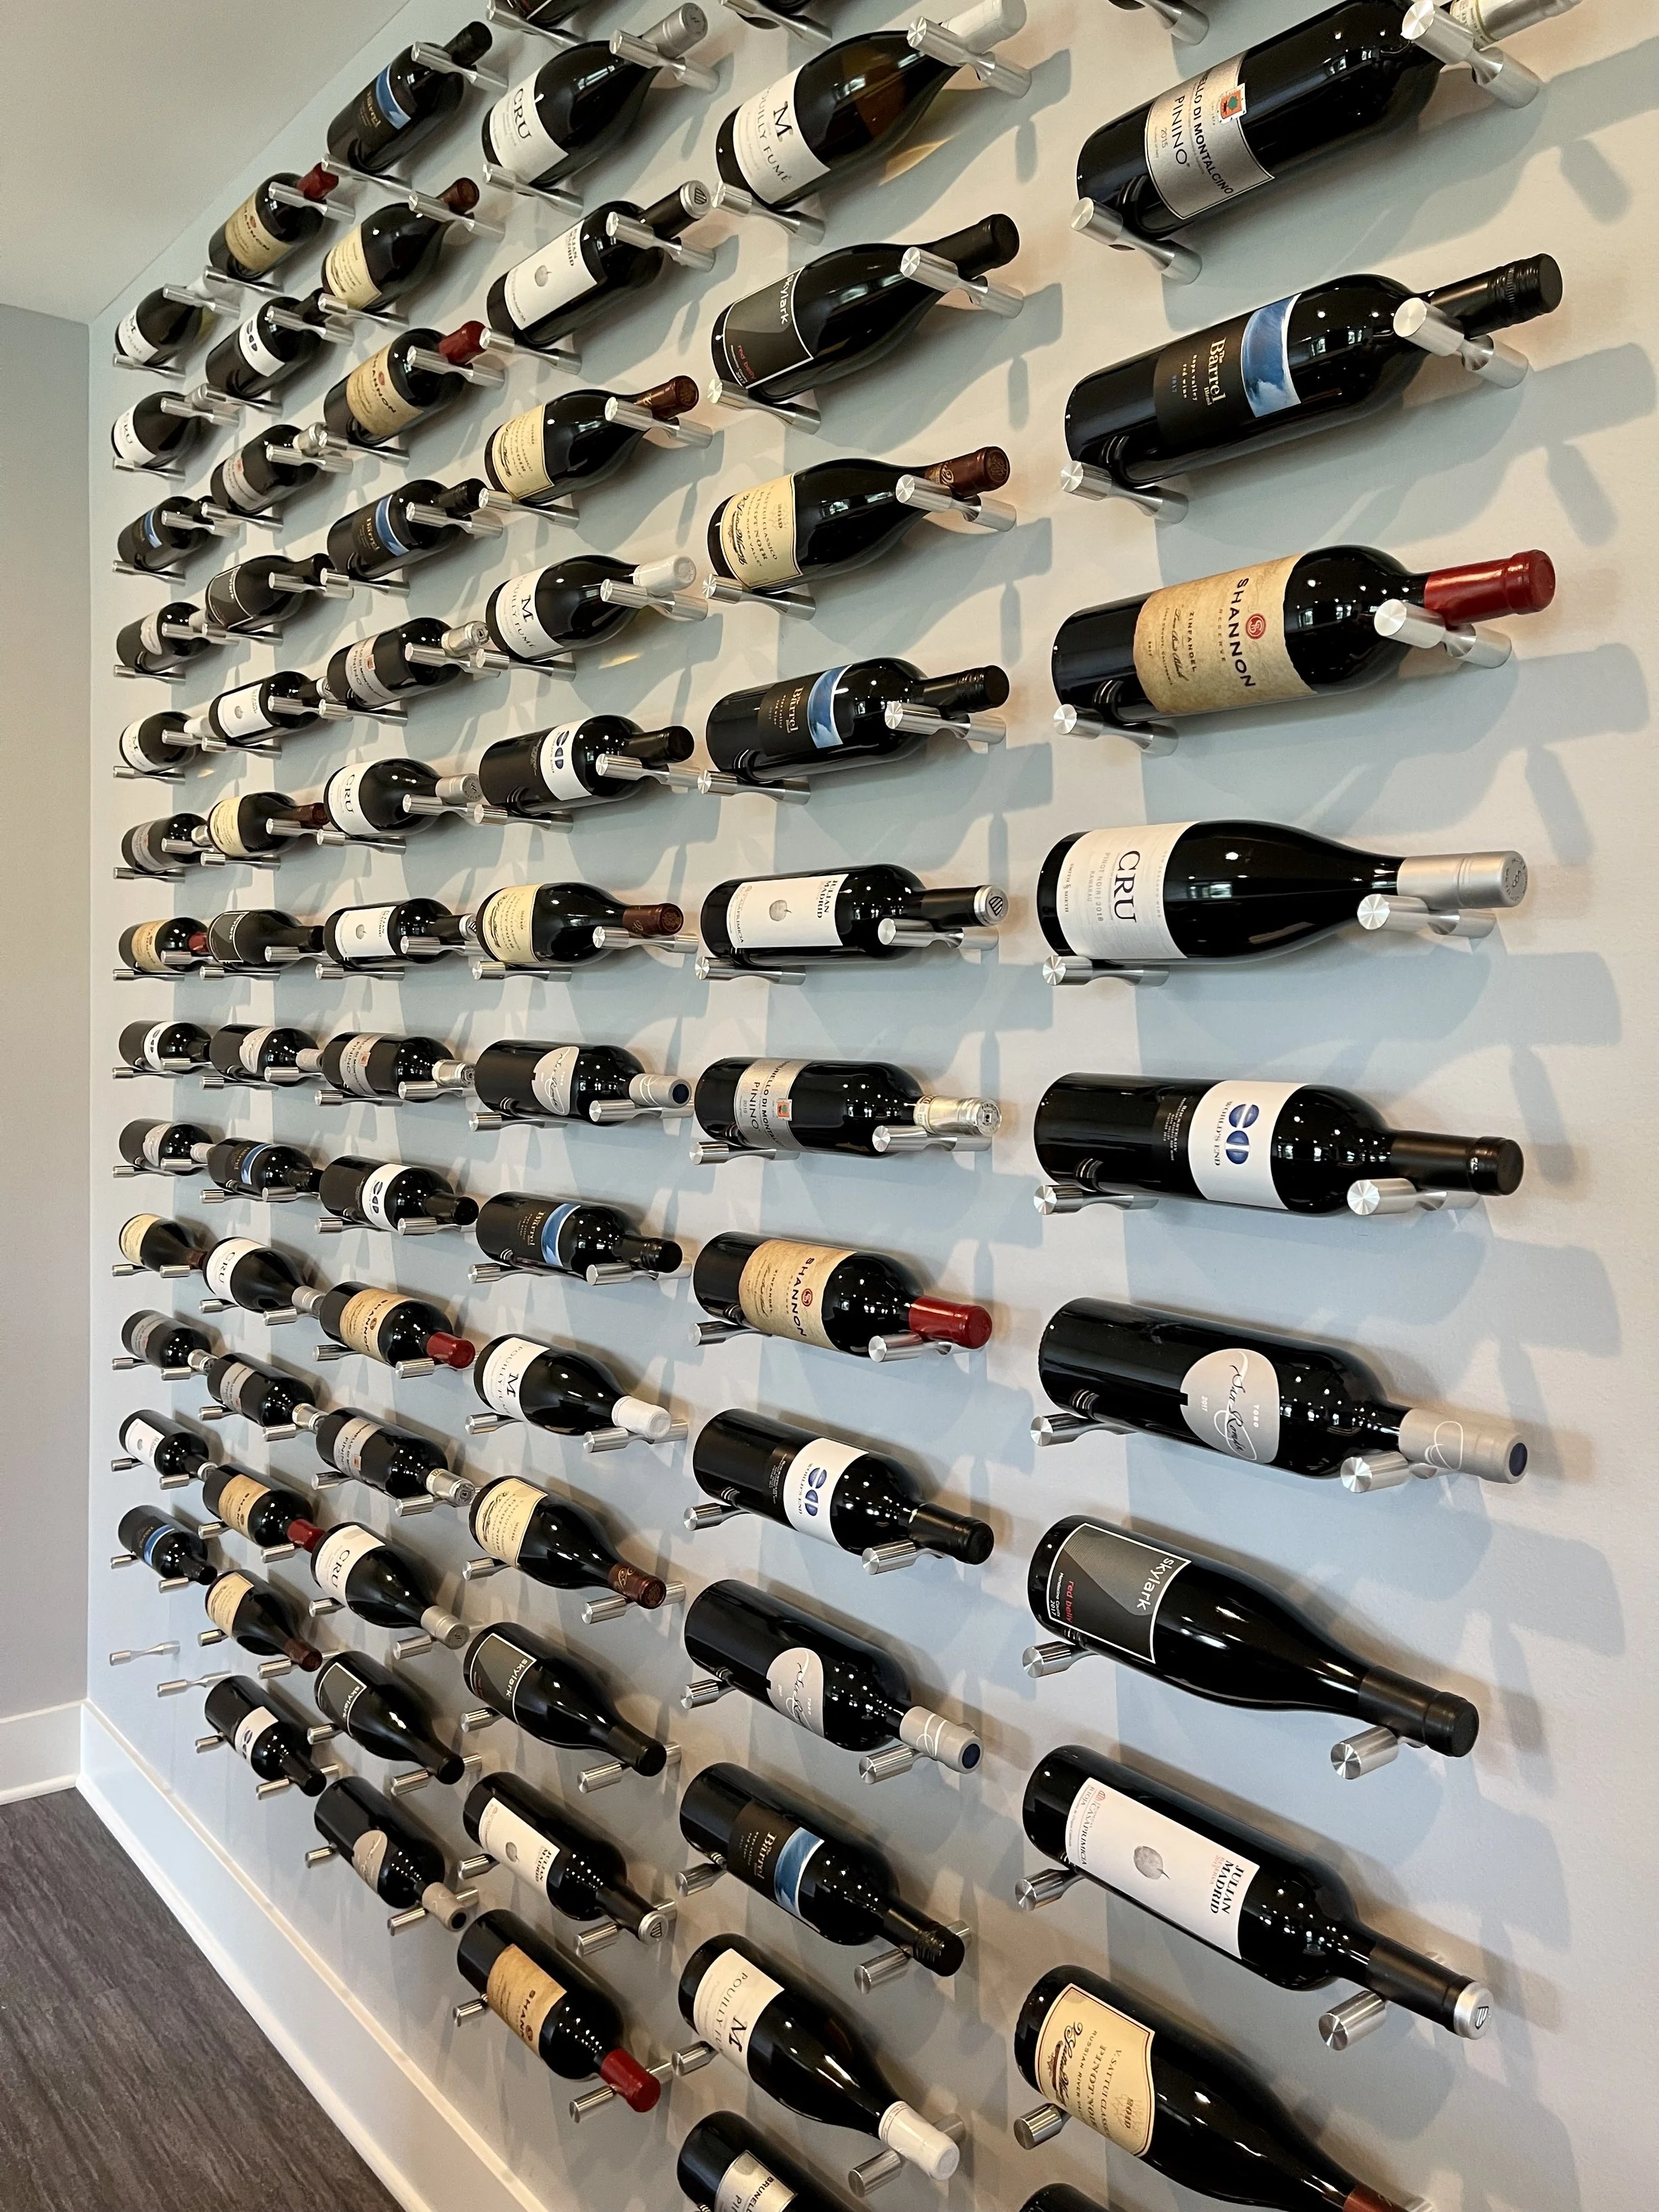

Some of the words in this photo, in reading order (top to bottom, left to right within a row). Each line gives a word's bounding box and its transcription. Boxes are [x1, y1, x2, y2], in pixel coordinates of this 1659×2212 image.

[514, 88, 532, 139] CRU
[773, 101, 793, 142] M
[1171, 95, 1188, 165] PININO
[1193, 109, 1202, 121] DI
[1194, 124, 1234, 194] MONTALCINO
[1208, 336, 1227, 404] Barrel
[521, 594, 534, 623] M
[1187, 611, 1196, 672] ZINFANDEL
[1217, 609, 1226, 662] RESERVE
[1228, 578, 1256, 687] SHANNON
[789, 686, 804, 731] Barrel
[344, 774, 355, 814] CRU
[1100, 852, 1111, 873] PINOT
[817, 880, 831, 919] MADRID
[824, 880, 838, 913] JULIAN
[1114, 850, 1141, 923] CRU
[749, 1082, 760, 1130] PININO
[762, 1098, 767, 1107] DI
[1214, 1100, 1233, 1142] WORLD'S
[218, 1252, 235, 1284] CRU
[791, 1258, 815, 1337] SHANNON
[507, 1372, 519, 1398] M
[331, 1549, 350, 1589] CRU
[1065, 1580, 1074, 1599] red
[1137, 1558, 1175, 1611] skylark
[1064, 1601, 1073, 1623] belly
[506, 1659, 528, 1698] skylark
[342, 1686, 360, 1719] skylark
[1080, 1786, 1095, 1805] RIOJA
[1080, 1803, 1096, 1865] CASAPRIMICIA
[1210, 1860, 1234, 1914] MADRID
[1221, 1866, 1245, 1915] JULIAN
[716, 1972, 748, 2024] POUILLY
[729, 2014, 748, 2053] M
[1079, 2031, 1098, 2069] RUSSIAN
[1087, 2044, 1107, 2096] PINOT
[1102, 2058, 1118, 2098] SATTUI
